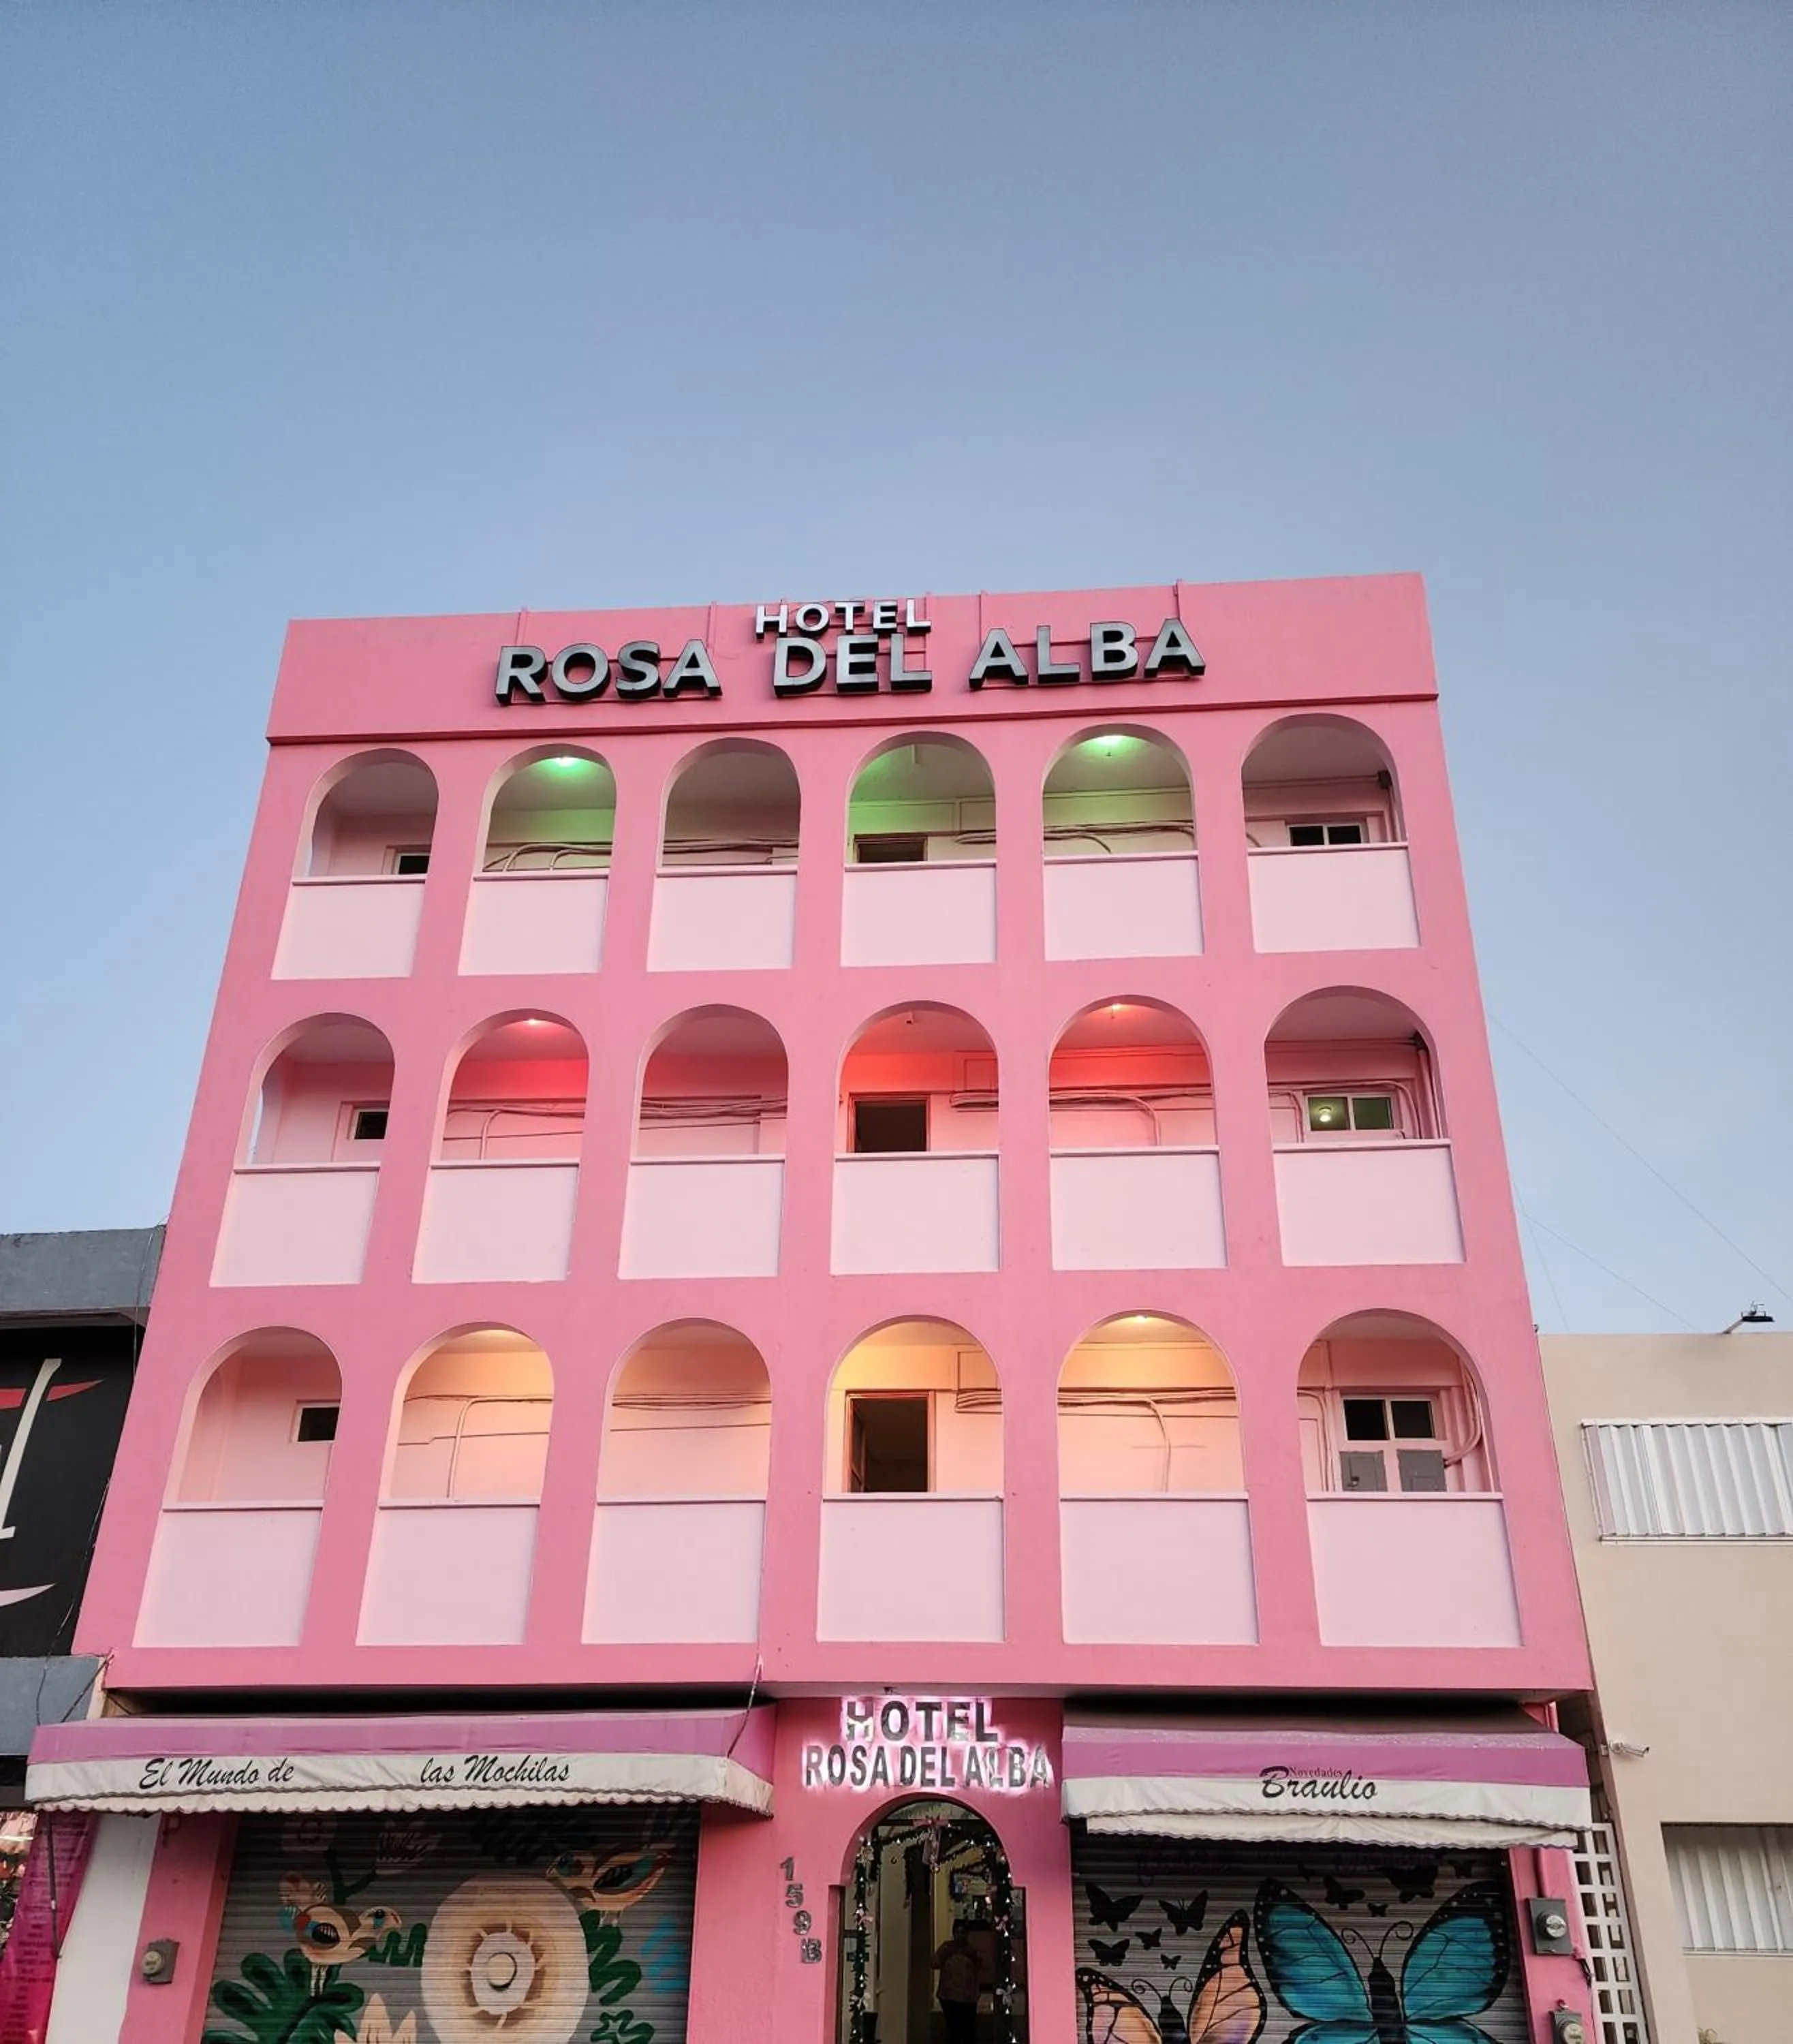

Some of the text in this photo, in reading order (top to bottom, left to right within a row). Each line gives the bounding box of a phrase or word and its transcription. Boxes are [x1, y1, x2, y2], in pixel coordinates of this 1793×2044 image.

[755, 597, 932, 640] HOTEL
[496, 618, 1206, 704] ROSA DEL ALBA
[846, 1701, 999, 1741] HOTEL
[139, 1757, 294, 1789] El Mundo de
[420, 1754, 570, 1784] las Mochilas
[805, 1745, 1050, 1787] ROSA DEL ALBA
[1259, 1765, 1377, 1799] Braulio
[1290, 1766, 1343, 1778] Novedades
